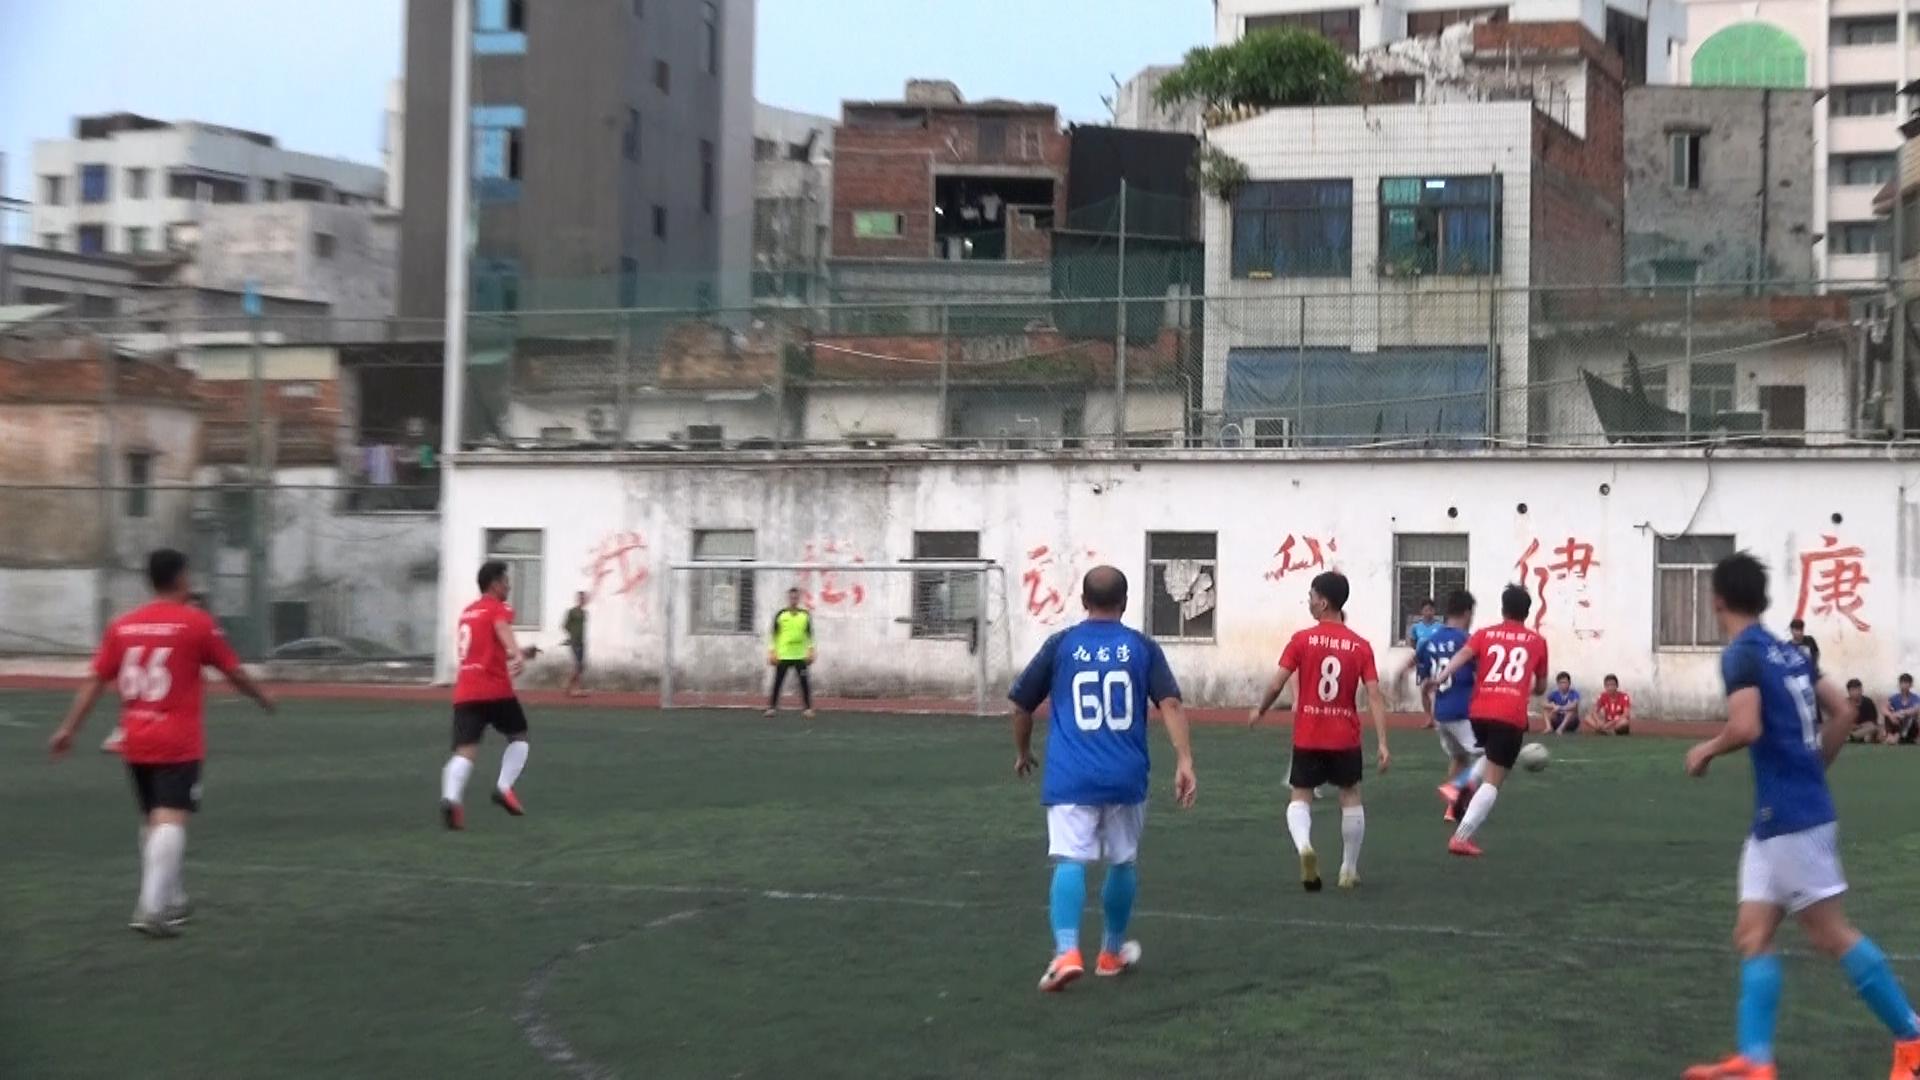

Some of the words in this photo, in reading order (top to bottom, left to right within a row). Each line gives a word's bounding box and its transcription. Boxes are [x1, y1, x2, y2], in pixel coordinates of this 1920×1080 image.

[1795, 534, 1870, 632] 康
[118, 646, 173, 702] 66
[1318, 655, 1342, 702] 8
[1484, 644, 1529, 683] 28
[1072, 670, 1134, 731] 60
